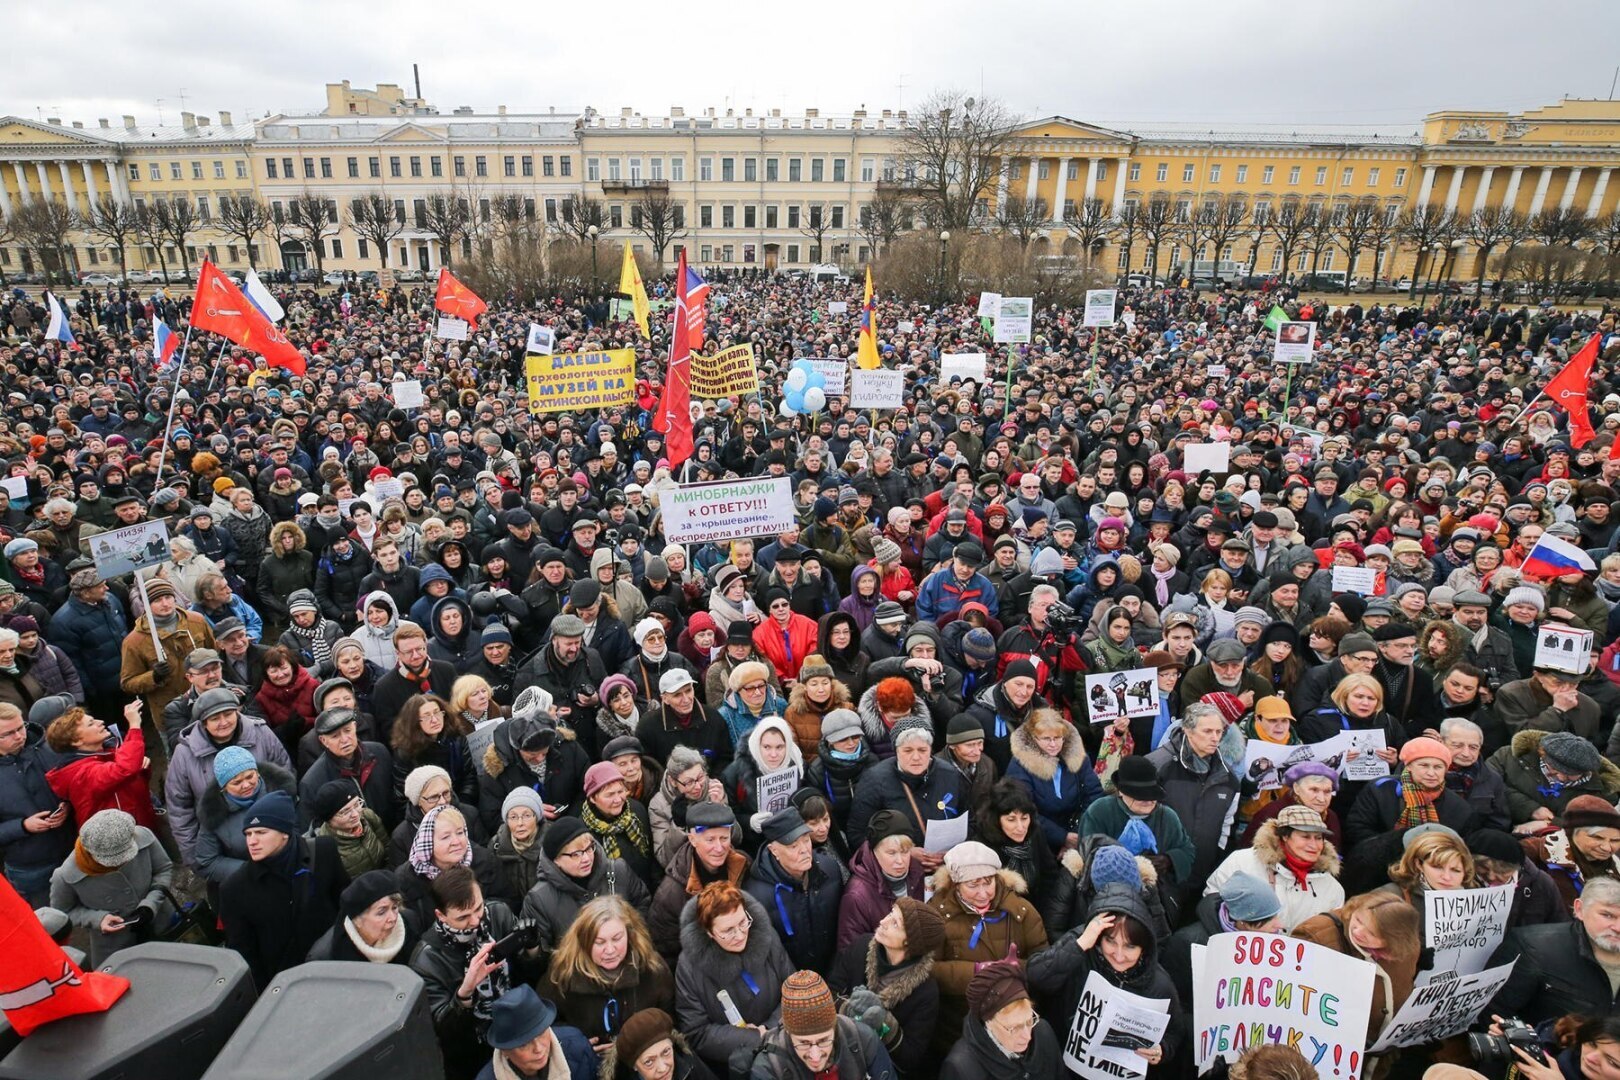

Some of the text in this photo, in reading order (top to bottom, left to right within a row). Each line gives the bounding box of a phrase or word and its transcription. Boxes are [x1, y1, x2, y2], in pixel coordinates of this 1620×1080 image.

[552, 353, 611, 370] ДАЕШЬ
[728, 348, 749, 360] ВЗЯТЬ
[531, 365, 632, 384] археологический
[690, 364, 719, 377] ЧТОЖИТЬ
[738, 358, 750, 369] ЛЕТ
[540, 378, 625, 396] МУЗЕЙ НА
[730, 380, 755, 392] МЫСУ!
[531, 390, 634, 409] ОХТИНСКОМ МЫСУ!
[673, 483, 775, 503] МИНОБРНАУКИ
[700, 499, 767, 516] ОТВЕТУ!!!
[116, 526, 146, 539] НИЗЯ!
[668, 530, 731, 543] беспредела
[744, 522, 789, 535] РГГМУ!!!
[1434, 890, 1506, 920] ПУБЛИЧКА
[1434, 915, 1493, 935] ВИСИТ НА
[1474, 923, 1502, 937] ИЗ-ЗА
[1216, 976, 1340, 1027] СПАСИТЕ
[1412, 979, 1461, 1007] КНИГИ
